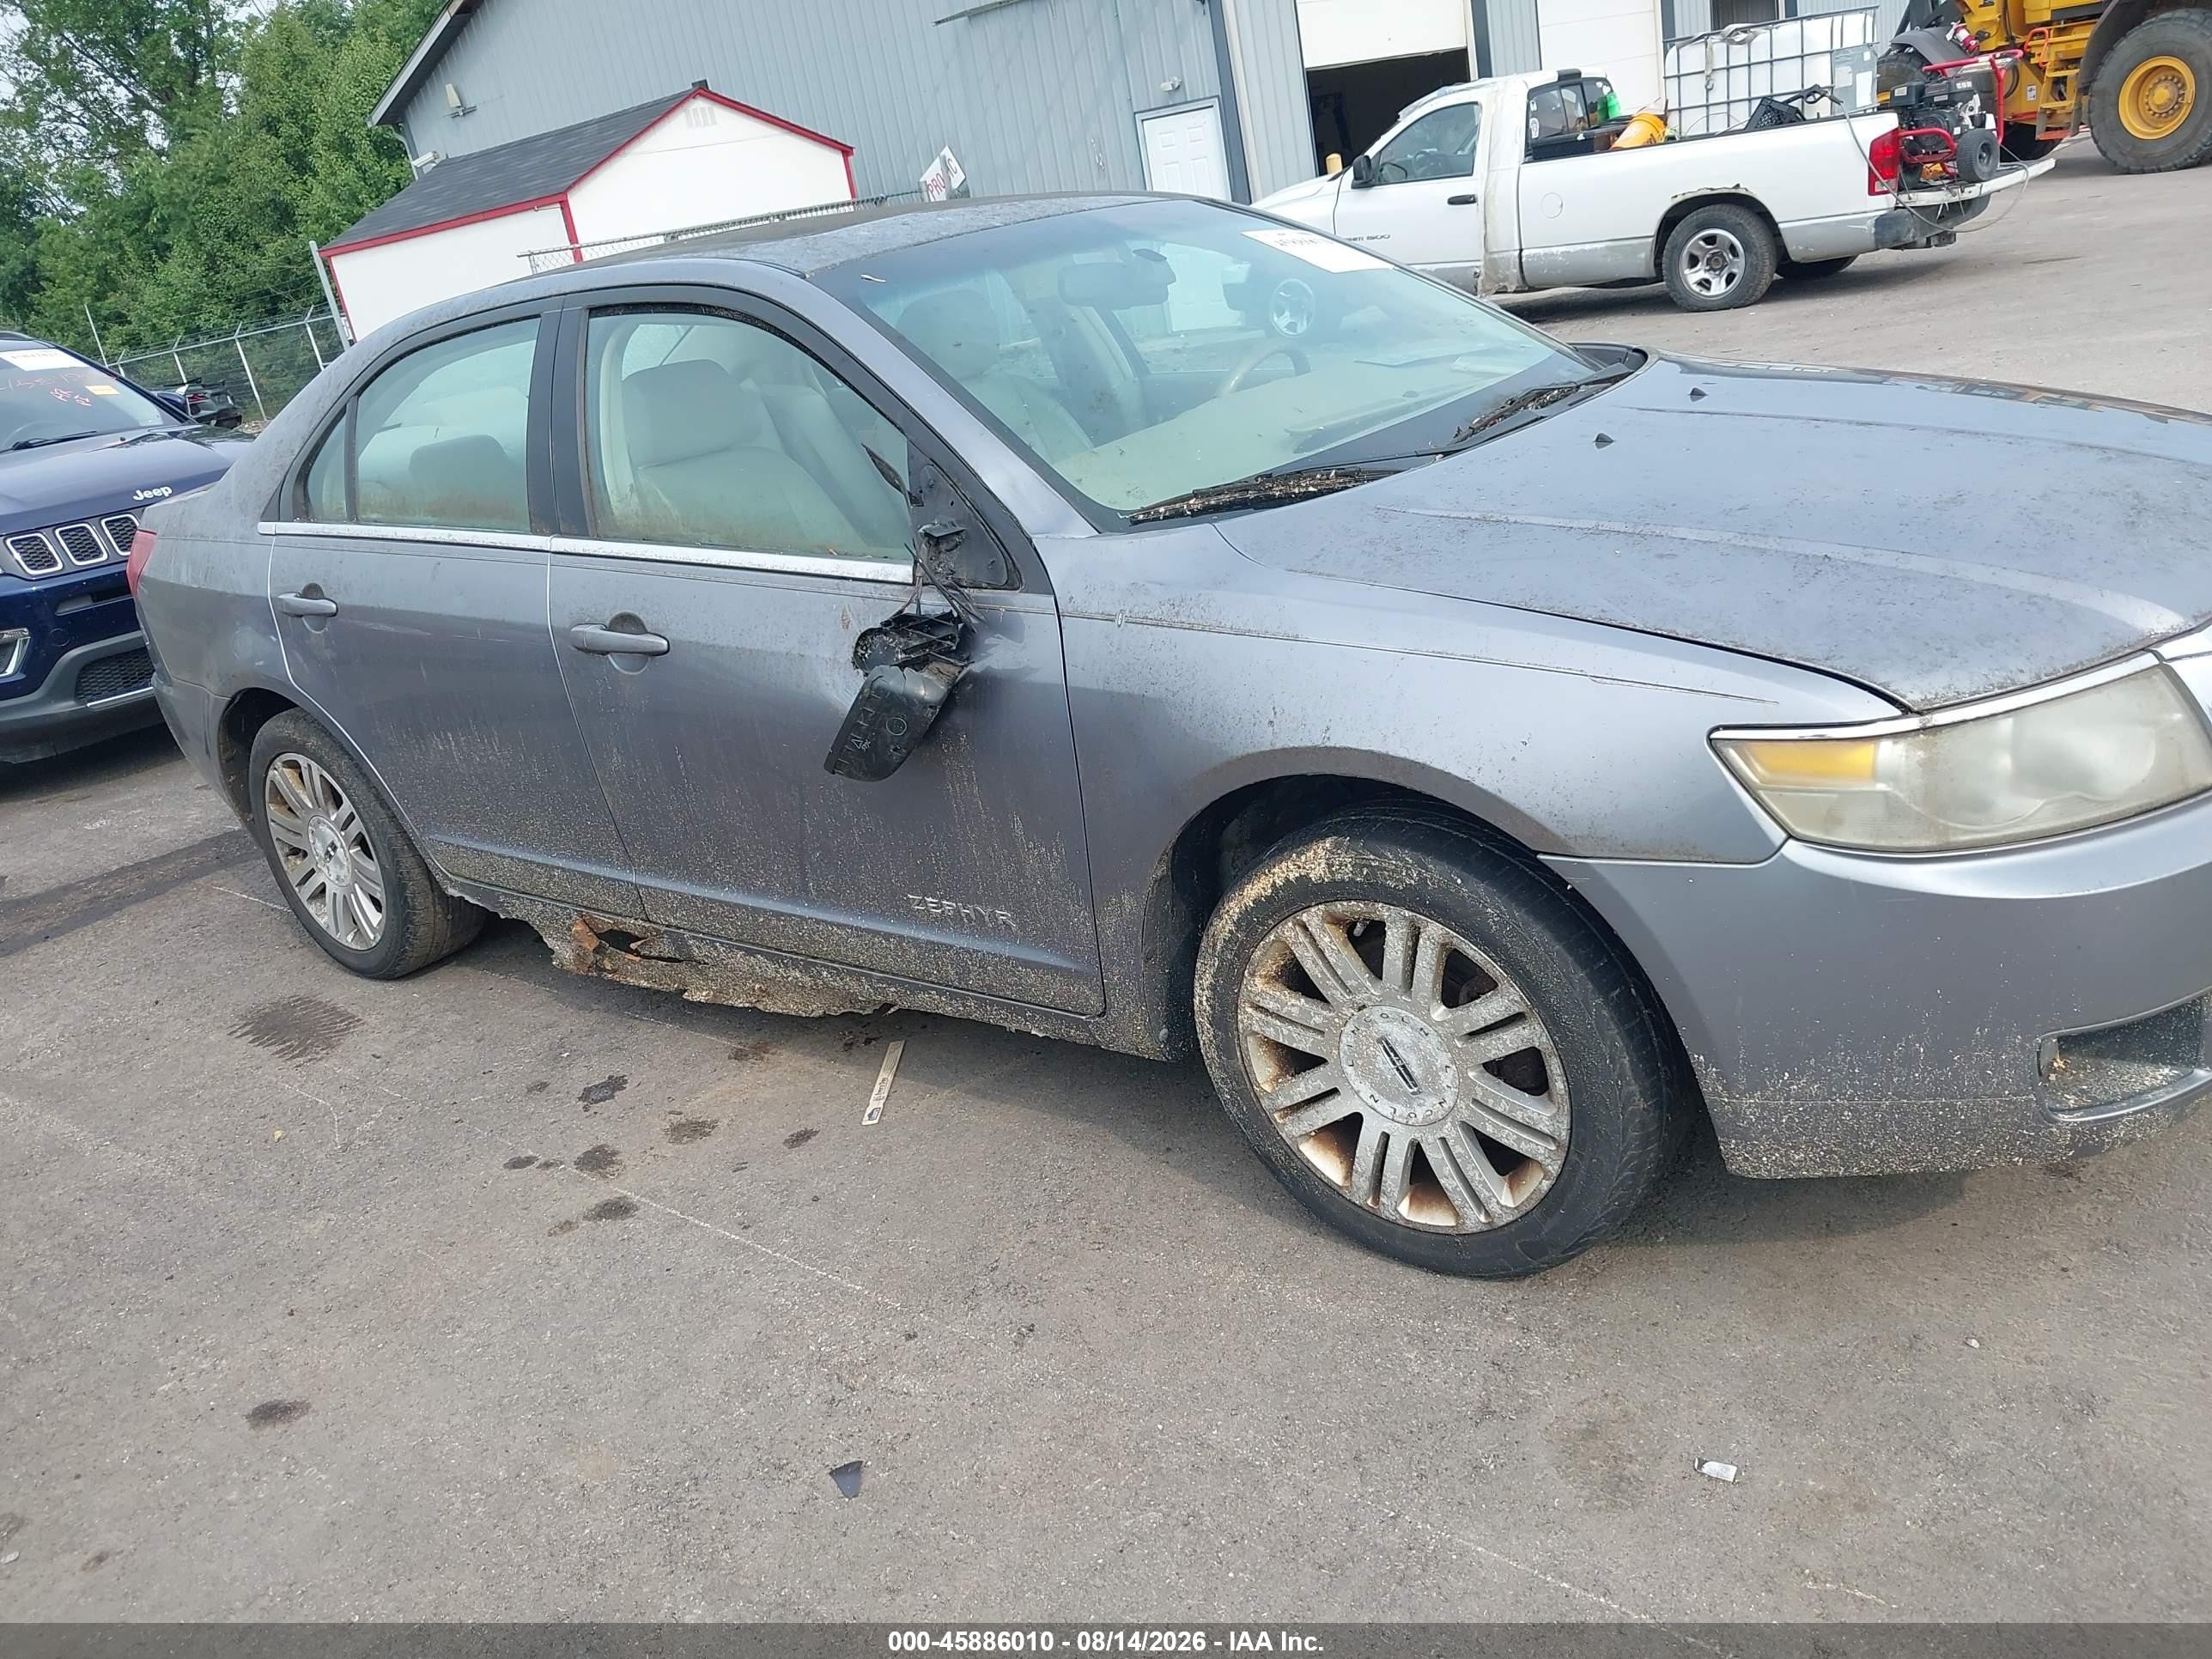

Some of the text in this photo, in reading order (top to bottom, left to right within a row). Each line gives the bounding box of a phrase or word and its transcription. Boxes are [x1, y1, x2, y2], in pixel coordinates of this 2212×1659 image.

[132, 486, 173, 501] Jeep
[907, 894, 1017, 927] ZEPHYR
[1346, 1012, 1430, 1067] LINCOLN
